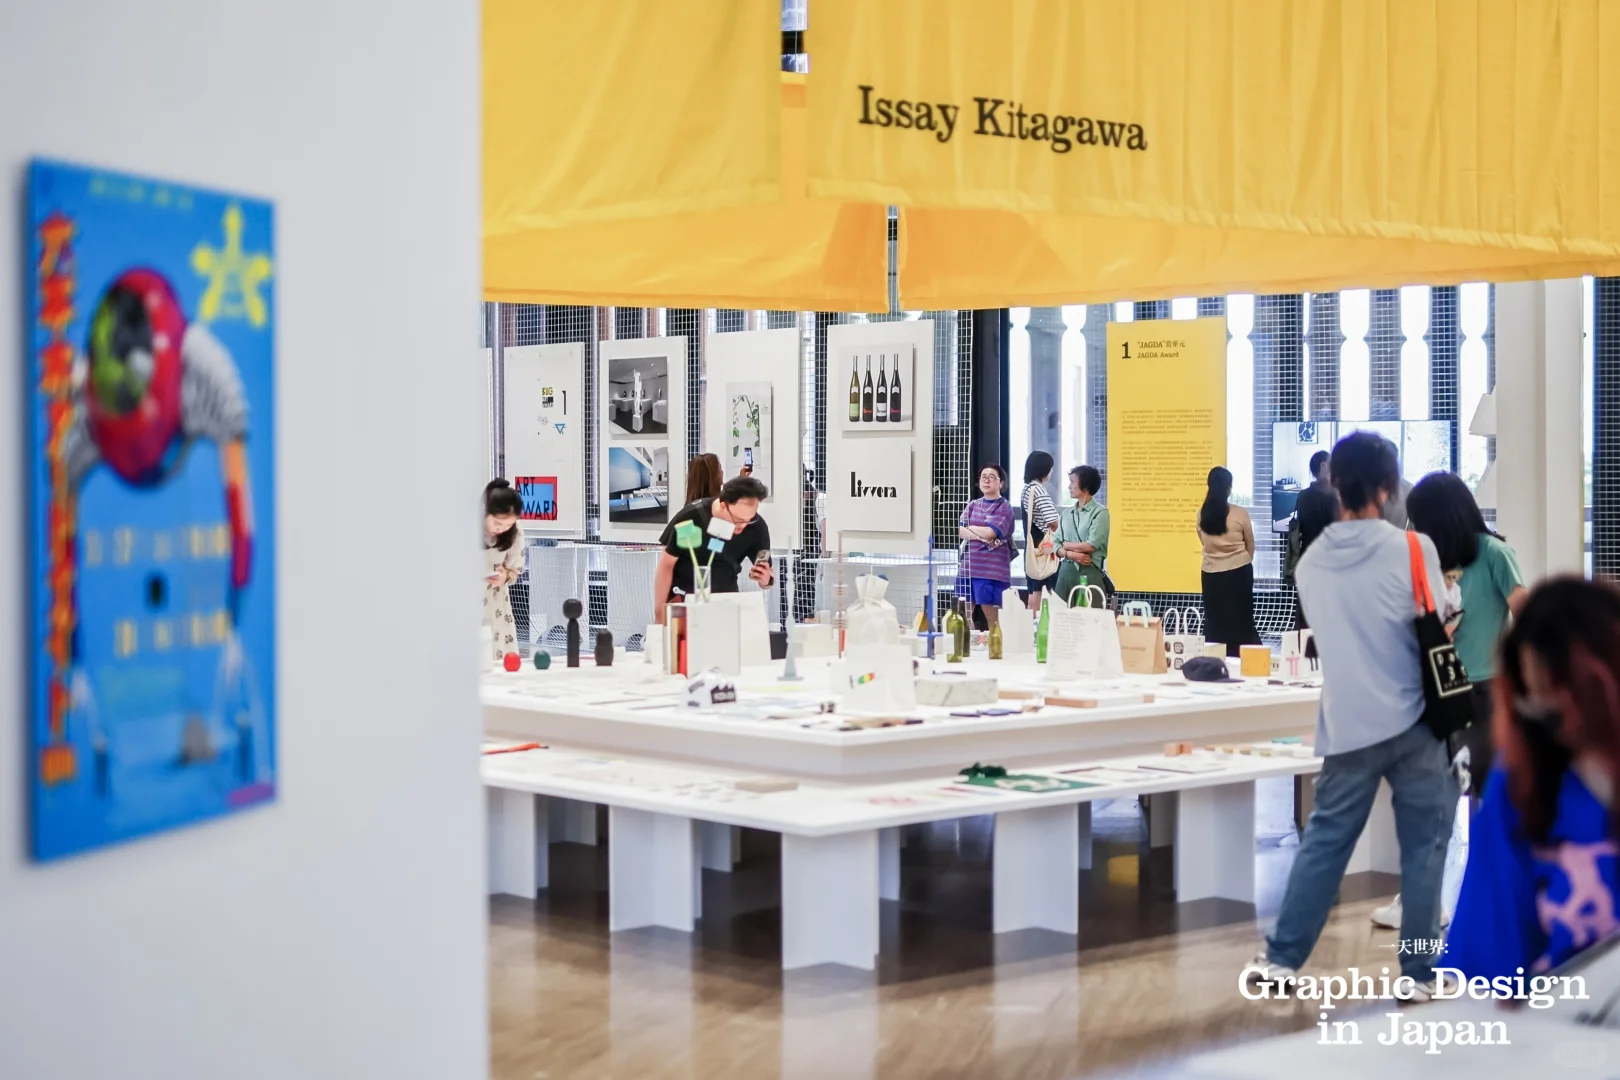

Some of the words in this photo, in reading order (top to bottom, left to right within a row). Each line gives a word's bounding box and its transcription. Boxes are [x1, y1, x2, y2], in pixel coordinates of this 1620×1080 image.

[857, 84, 960, 143] Issay
[972, 96, 1148, 154] Kitagawa
[1121, 341, 1132, 359] 1
[515, 477, 536, 496] ART
[520, 500, 558, 521] WARD
